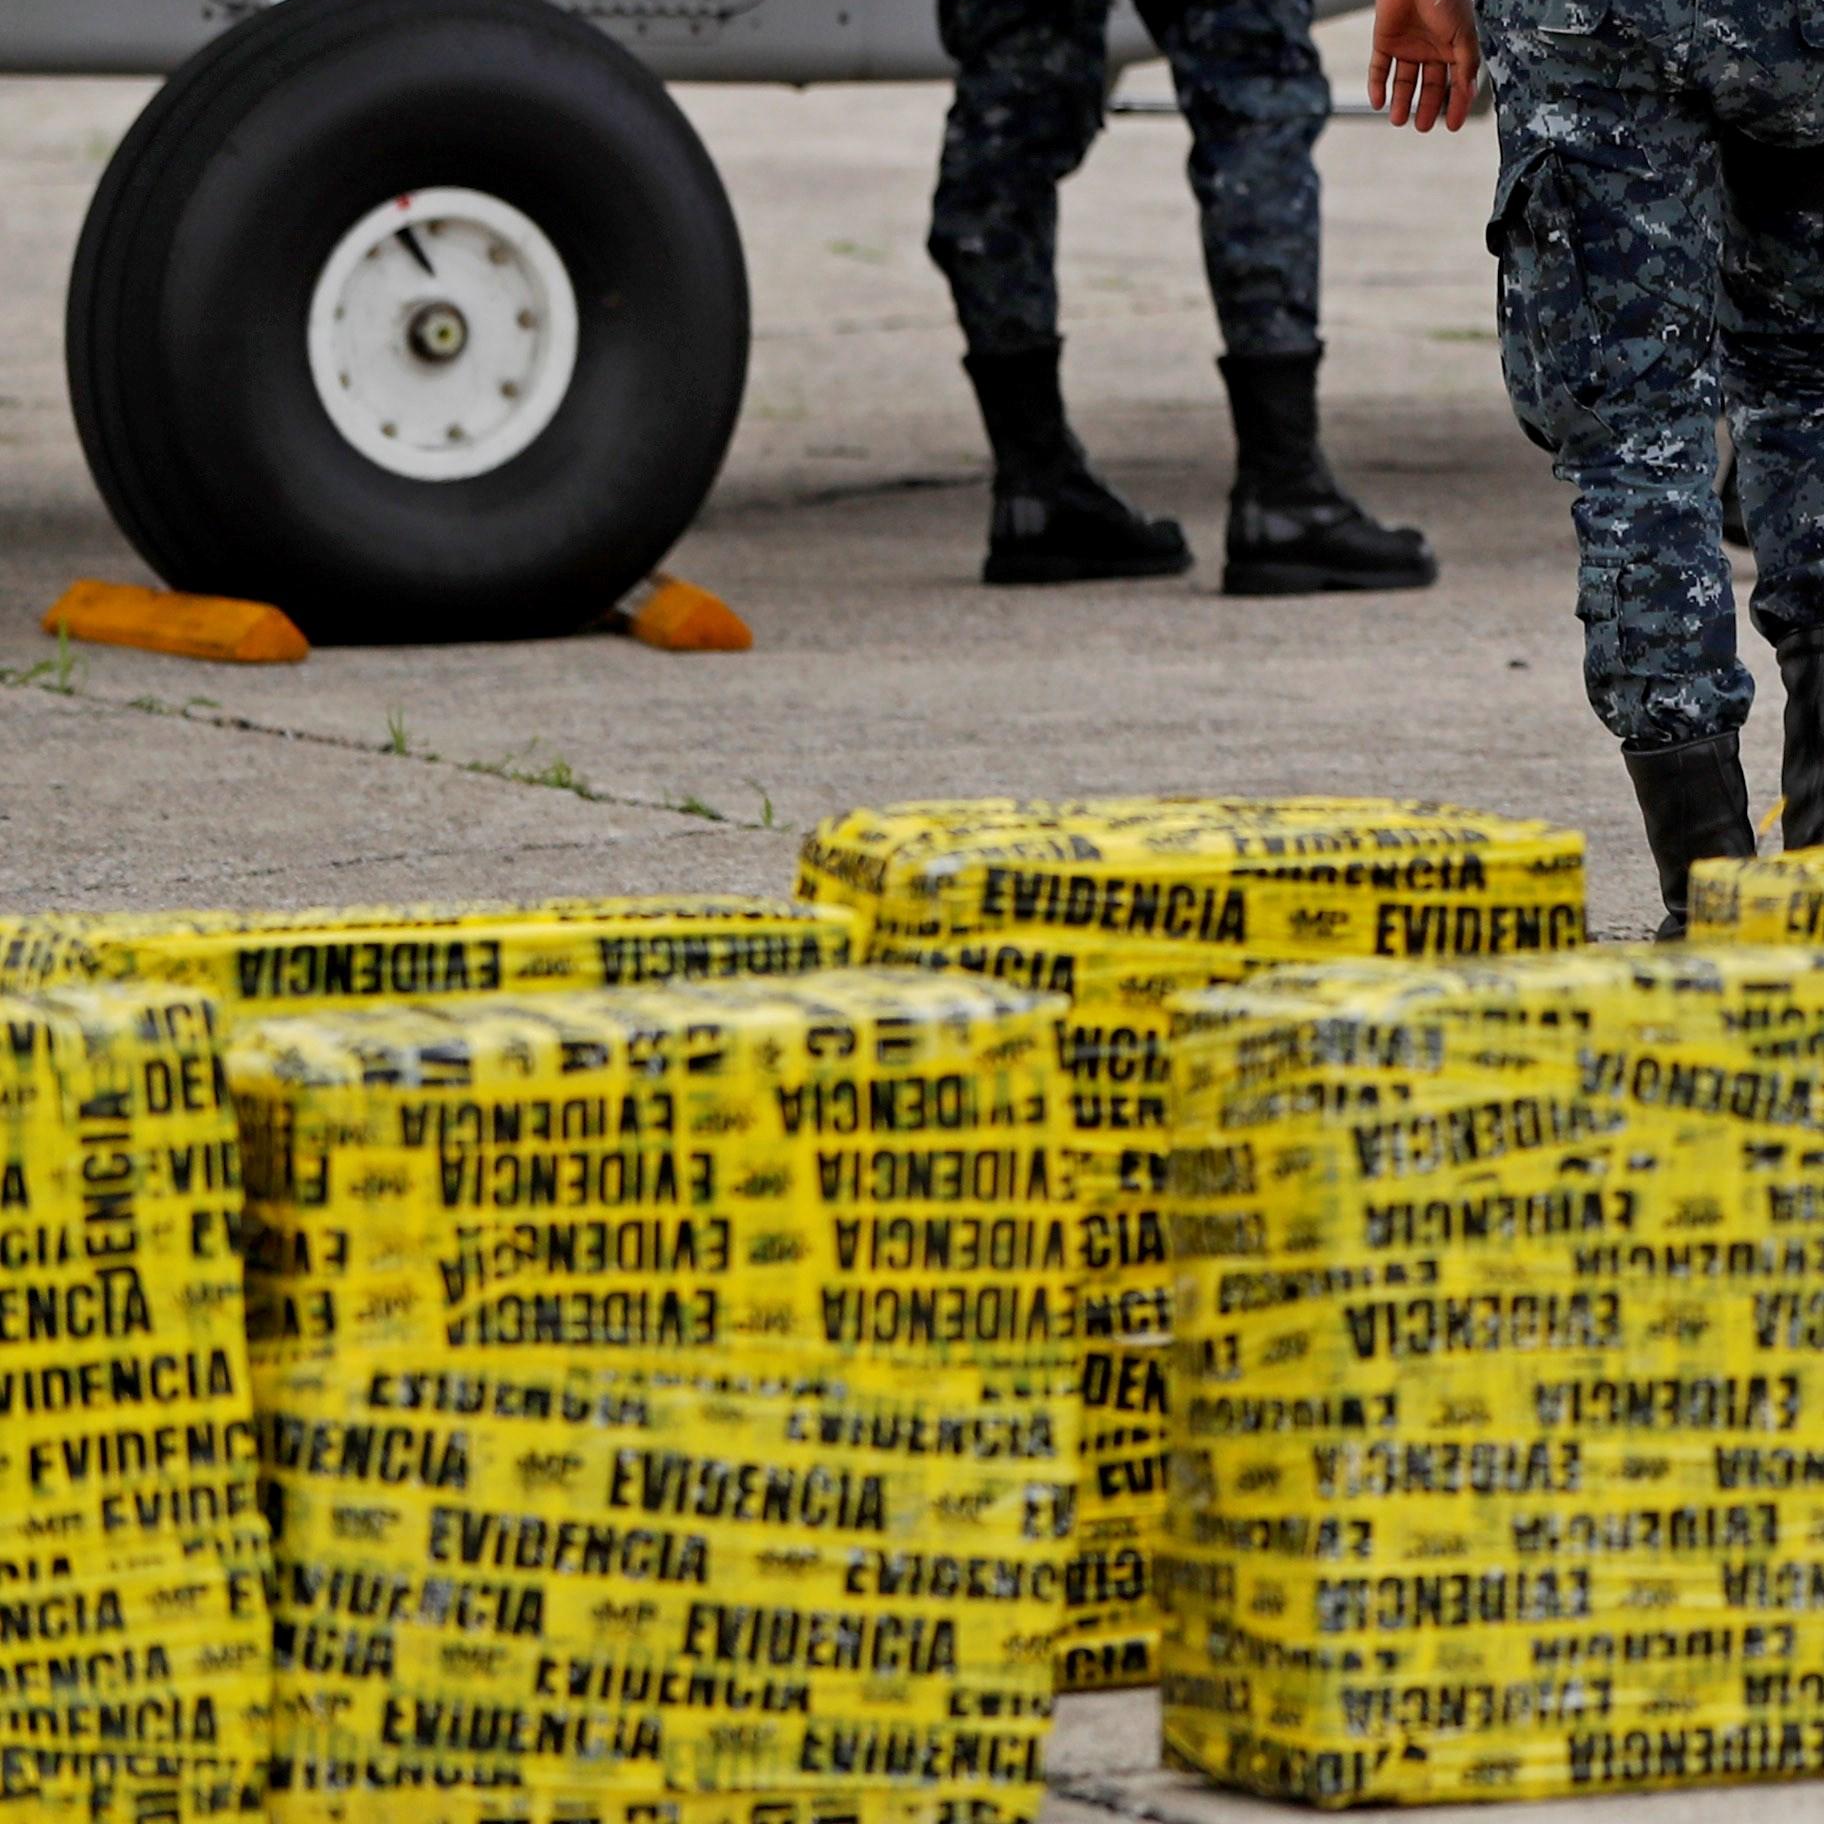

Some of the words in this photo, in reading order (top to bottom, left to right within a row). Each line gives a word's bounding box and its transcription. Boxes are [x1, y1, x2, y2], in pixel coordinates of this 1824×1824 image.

[978, 866, 1247, 945] EVIDENCIA
[235, 940, 501, 998] EVIDENCIA
[402, 1093, 675, 1148] EVIDENCIA
[437, 1150, 718, 1209] EVIDENCIA
[814, 1145, 1078, 1204] EVIDENCIA
[1361, 1189, 1636, 1248] EVIDENCIA
[443, 1288, 719, 1346] EVIDENCIA
[1344, 1290, 1622, 1359] EVIDENCIA
[608, 1447, 887, 1532] EVIDENCIA
[1312, 1438, 1583, 1497] EVIDENCIA
[428, 1504, 709, 1584] EVIDENCIA
[1314, 1572, 1591, 1633] EVIDENCIA
[682, 1602, 957, 1676] EVIDENCIA
